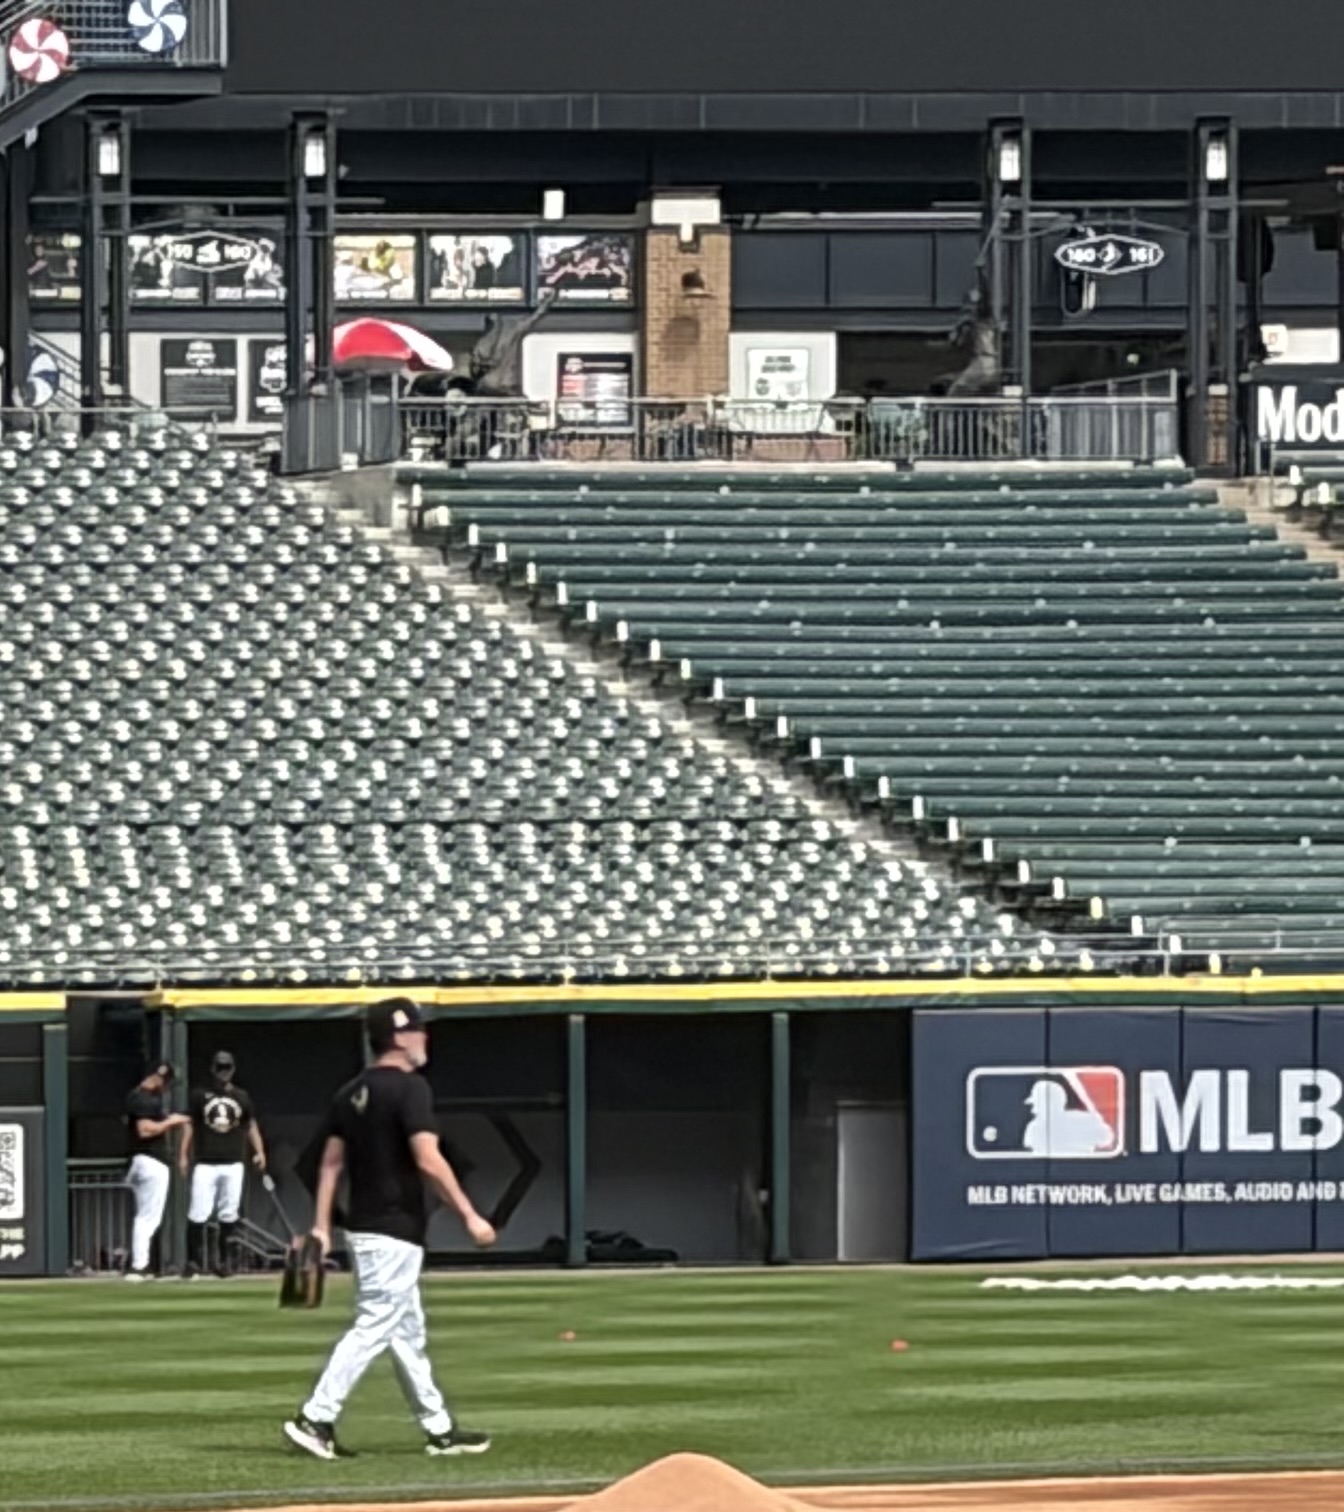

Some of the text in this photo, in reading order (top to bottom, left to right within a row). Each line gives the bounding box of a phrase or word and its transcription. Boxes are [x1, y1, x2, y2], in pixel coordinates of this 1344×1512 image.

[1139, 1069, 1344, 1152] MLB
[967, 1184, 1009, 1205] MLB
[1011, 1183, 1113, 1206] NETWORK,
[1114, 1183, 1157, 1204] LIVE
[1158, 1181, 1233, 1205] GAMES,
[1234, 1181, 1294, 1203] AUDIO
[1296, 1180, 1337, 1202] AND
